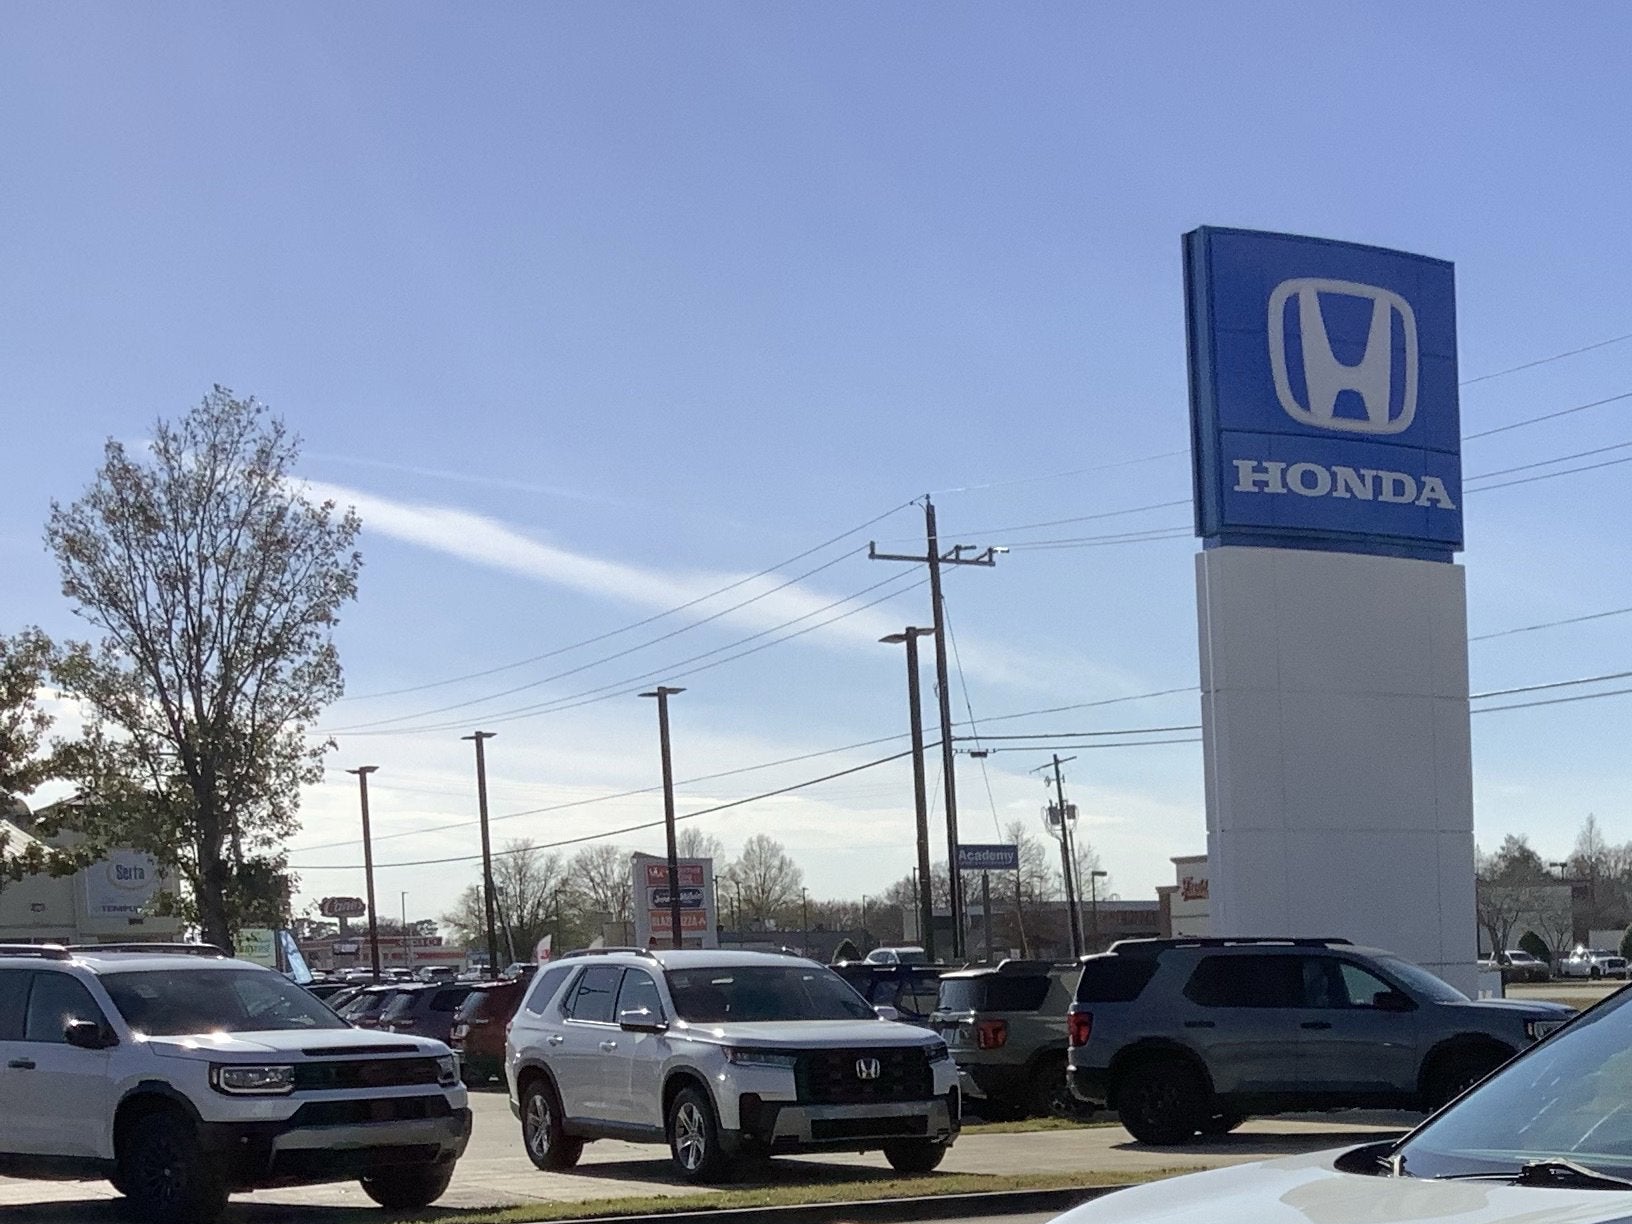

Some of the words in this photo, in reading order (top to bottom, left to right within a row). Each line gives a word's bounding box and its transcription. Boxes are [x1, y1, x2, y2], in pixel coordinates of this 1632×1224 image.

[1233, 459, 1456, 510] HONDA
[958, 850, 1014, 864] Academy
[115, 865, 145, 880] Serta
